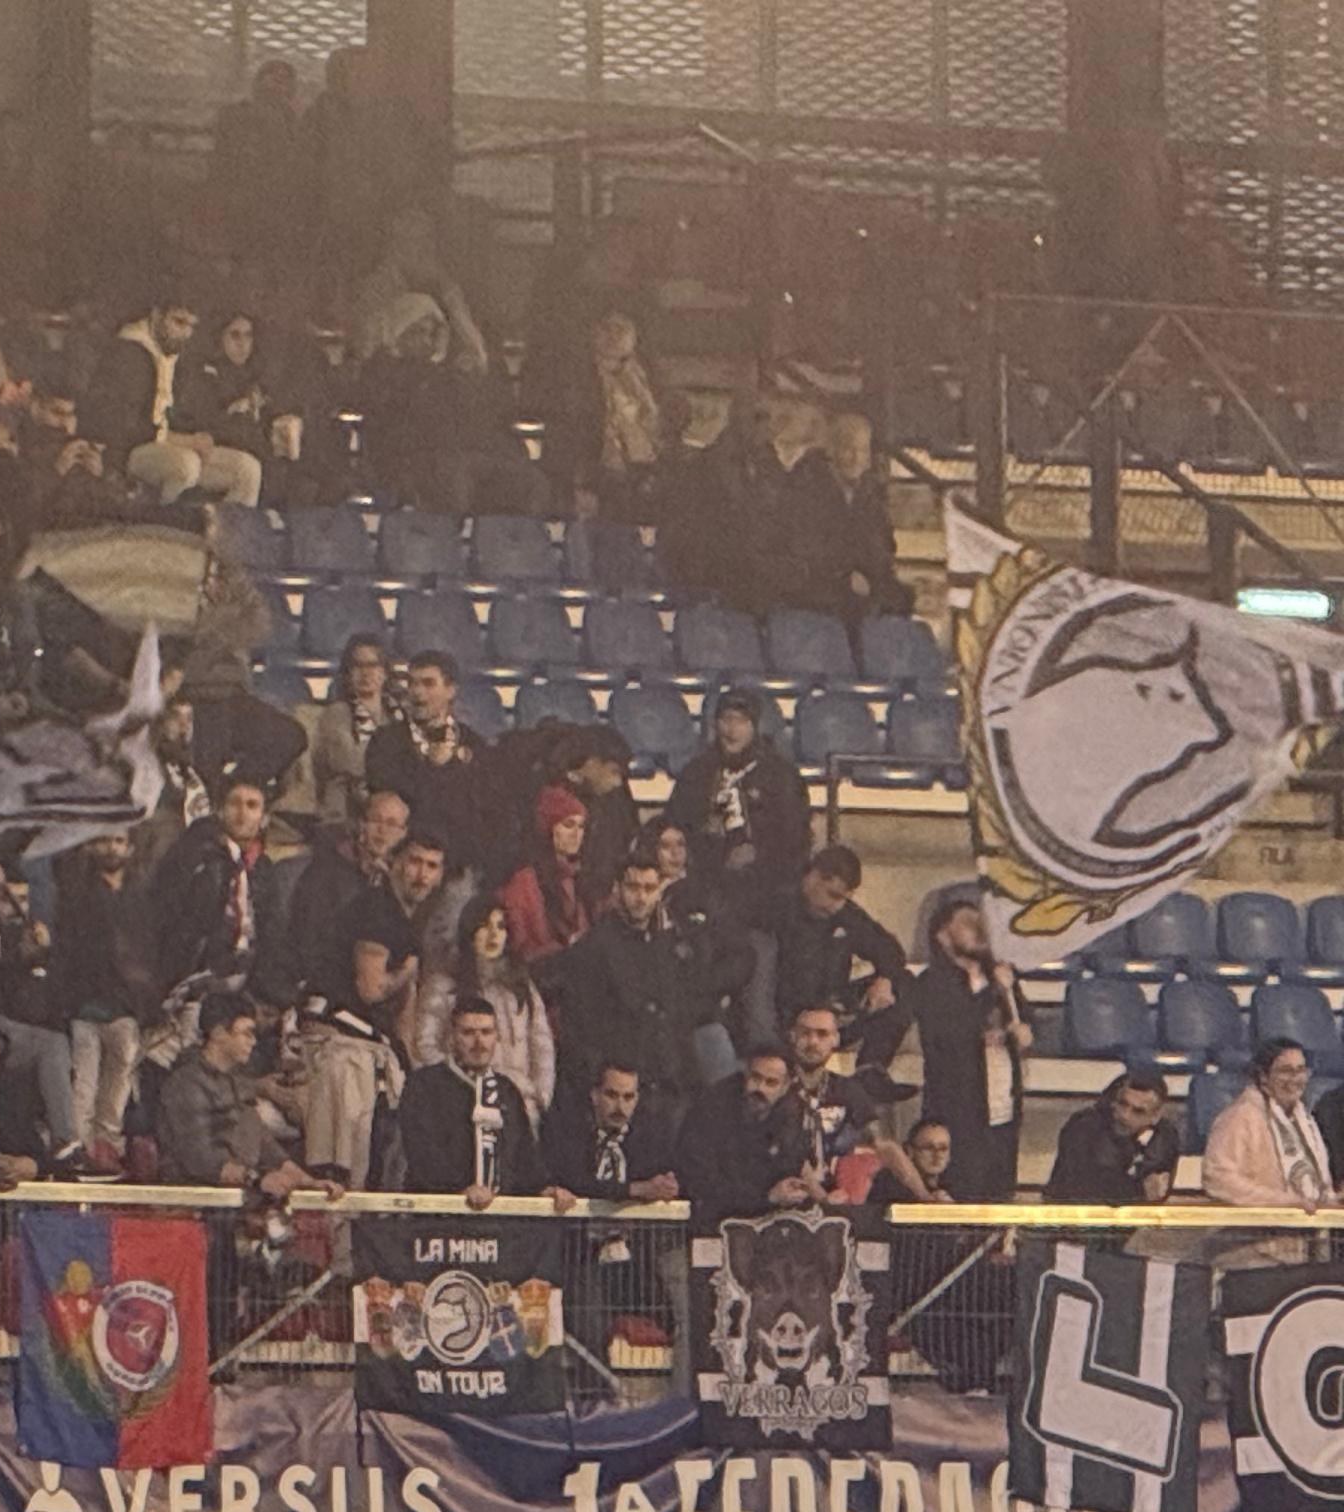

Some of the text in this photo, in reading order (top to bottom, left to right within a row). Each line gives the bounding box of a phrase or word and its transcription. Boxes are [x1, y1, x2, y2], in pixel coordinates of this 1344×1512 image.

[415, 1237, 444, 1263] LA
[416, 1369, 507, 1399] ON TOUR
[720, 1382, 869, 1420] VERRACOS
